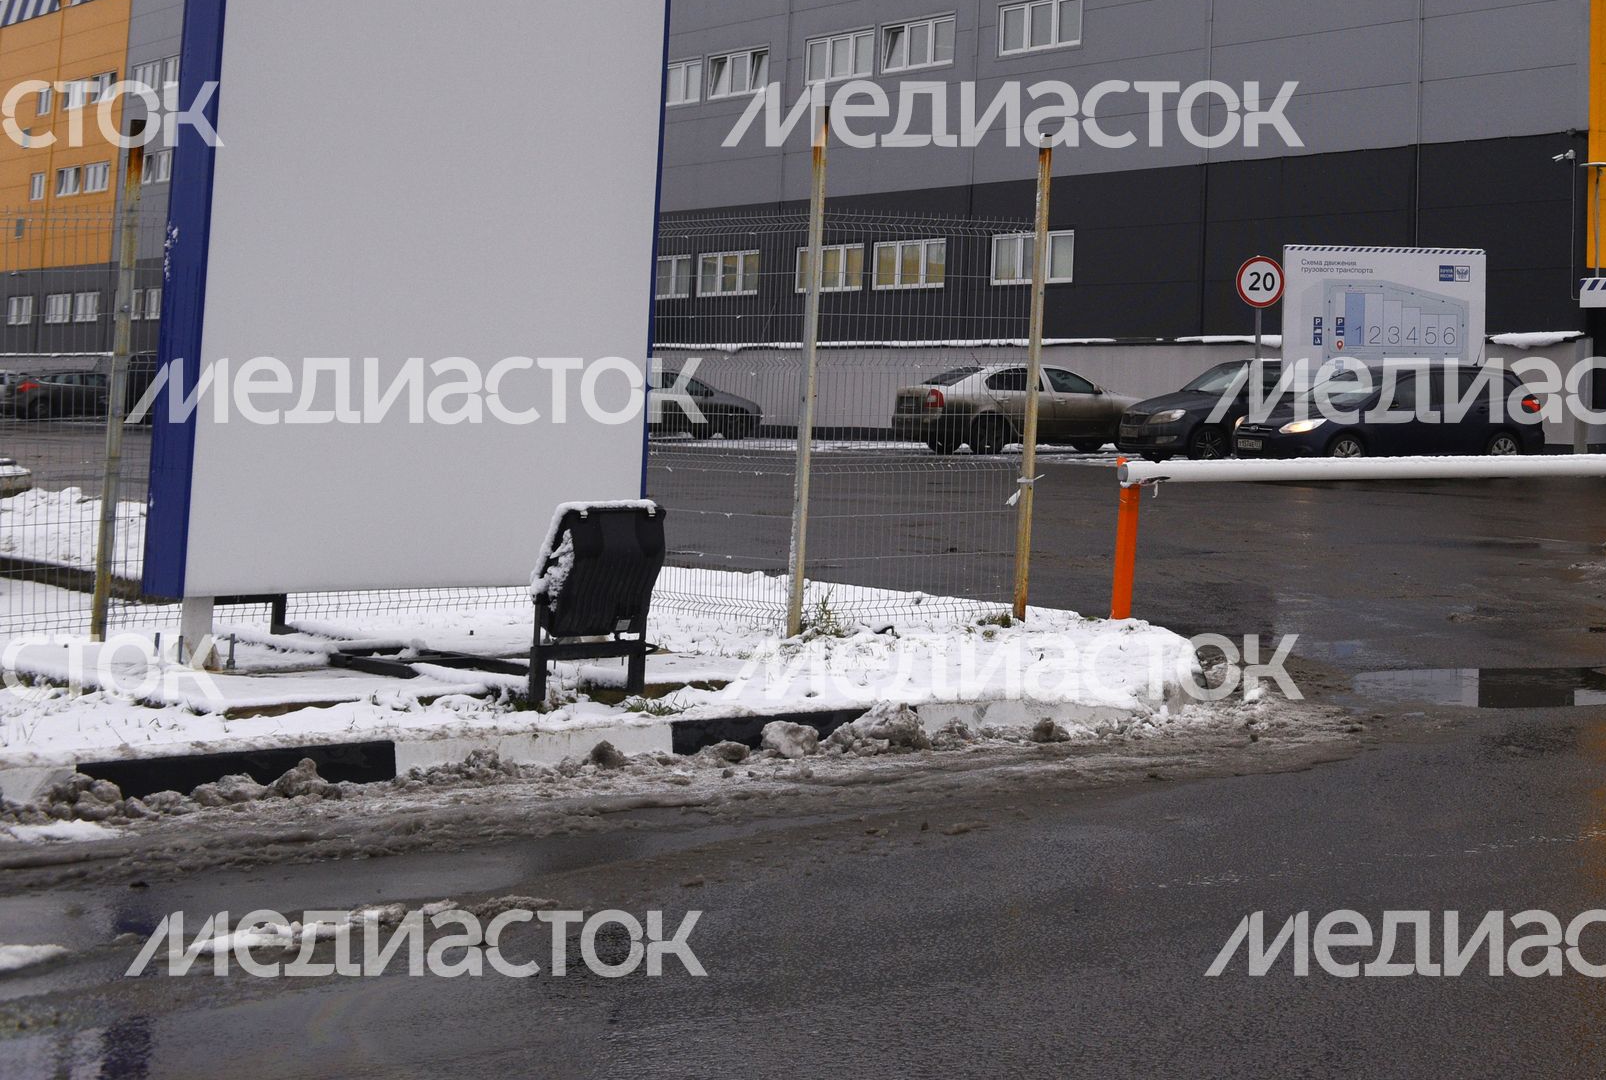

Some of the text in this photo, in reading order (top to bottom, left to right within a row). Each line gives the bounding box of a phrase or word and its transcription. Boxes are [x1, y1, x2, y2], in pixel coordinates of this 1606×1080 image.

[1301, 258, 1323, 266] Схема
[1301, 266, 1374, 275] грузового транспорта
[1248, 271, 1275, 292] 20
[1354, 326, 1456, 345] 1 2 3 4 5 6
